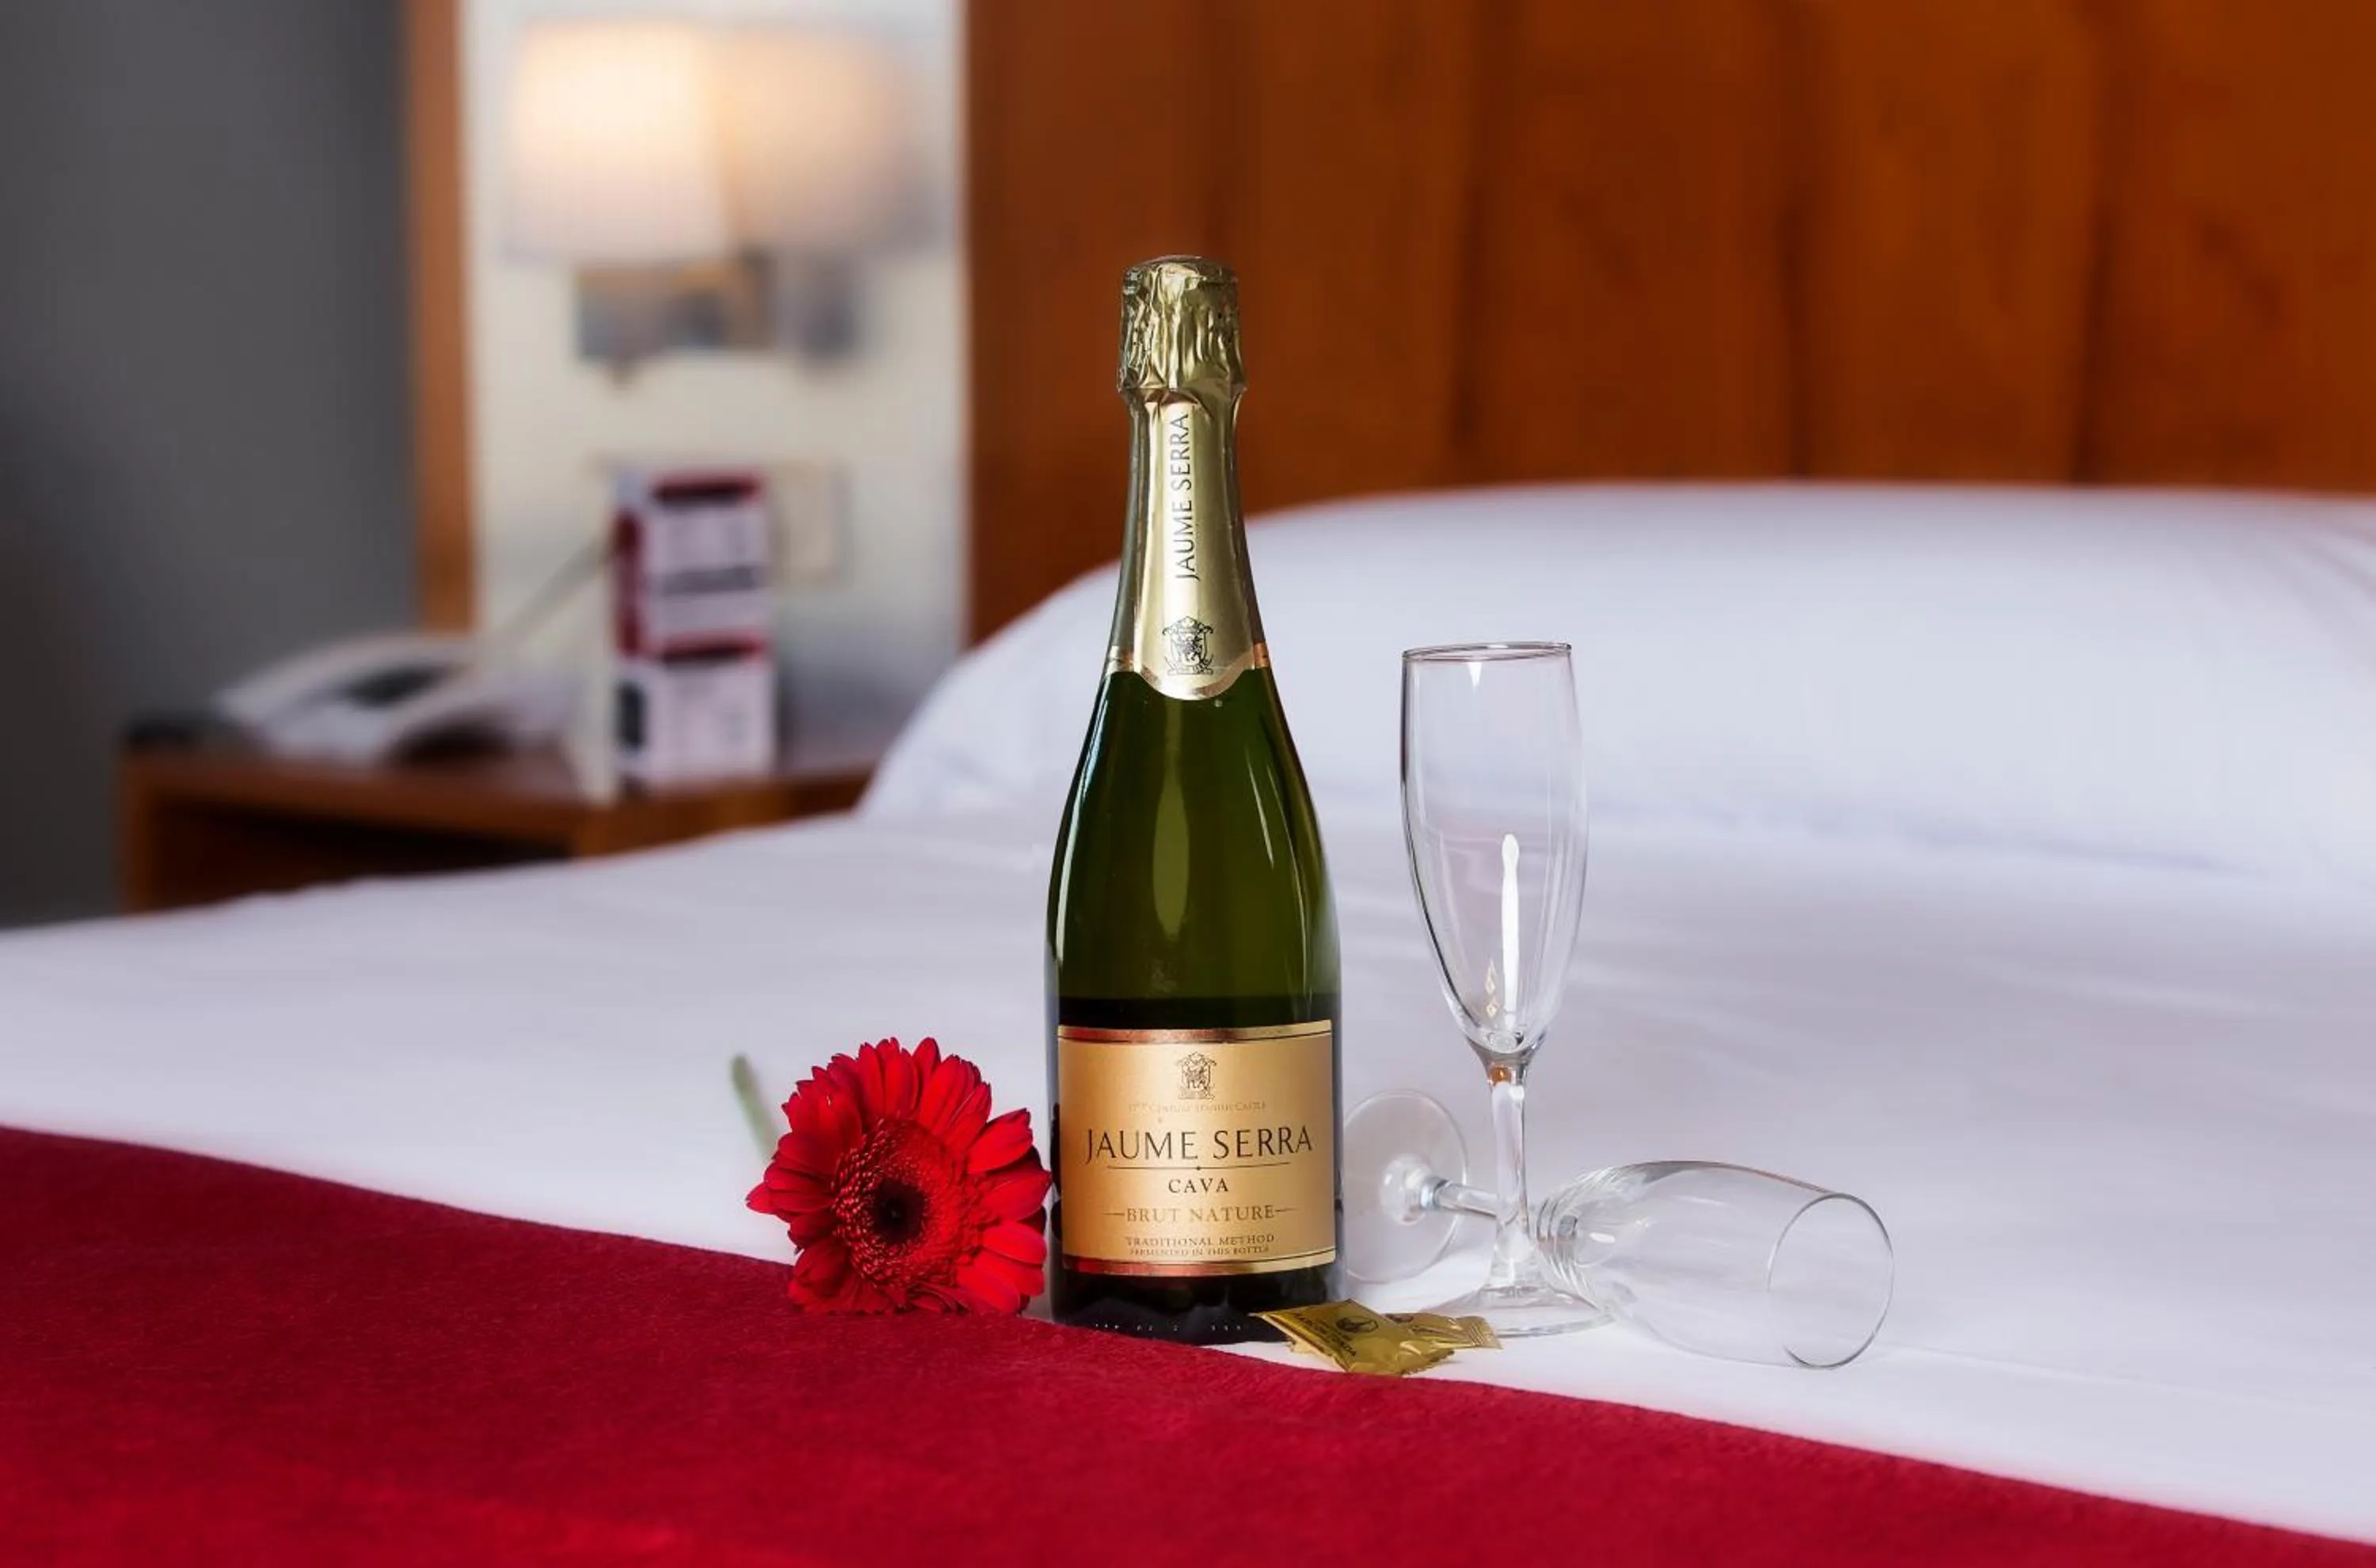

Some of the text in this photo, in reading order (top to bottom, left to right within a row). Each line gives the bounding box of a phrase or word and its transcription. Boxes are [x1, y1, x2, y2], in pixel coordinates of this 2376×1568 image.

[1169, 413, 1201, 582] JAUME SERRA
[1084, 1125, 1314, 1165] JAUME SERRA
[1167, 1178, 1229, 1193] CAVA
[1126, 1205, 1275, 1223] BRUT NATURE
[1125, 1233, 1275, 1247] TRADITIONAL METHOD
